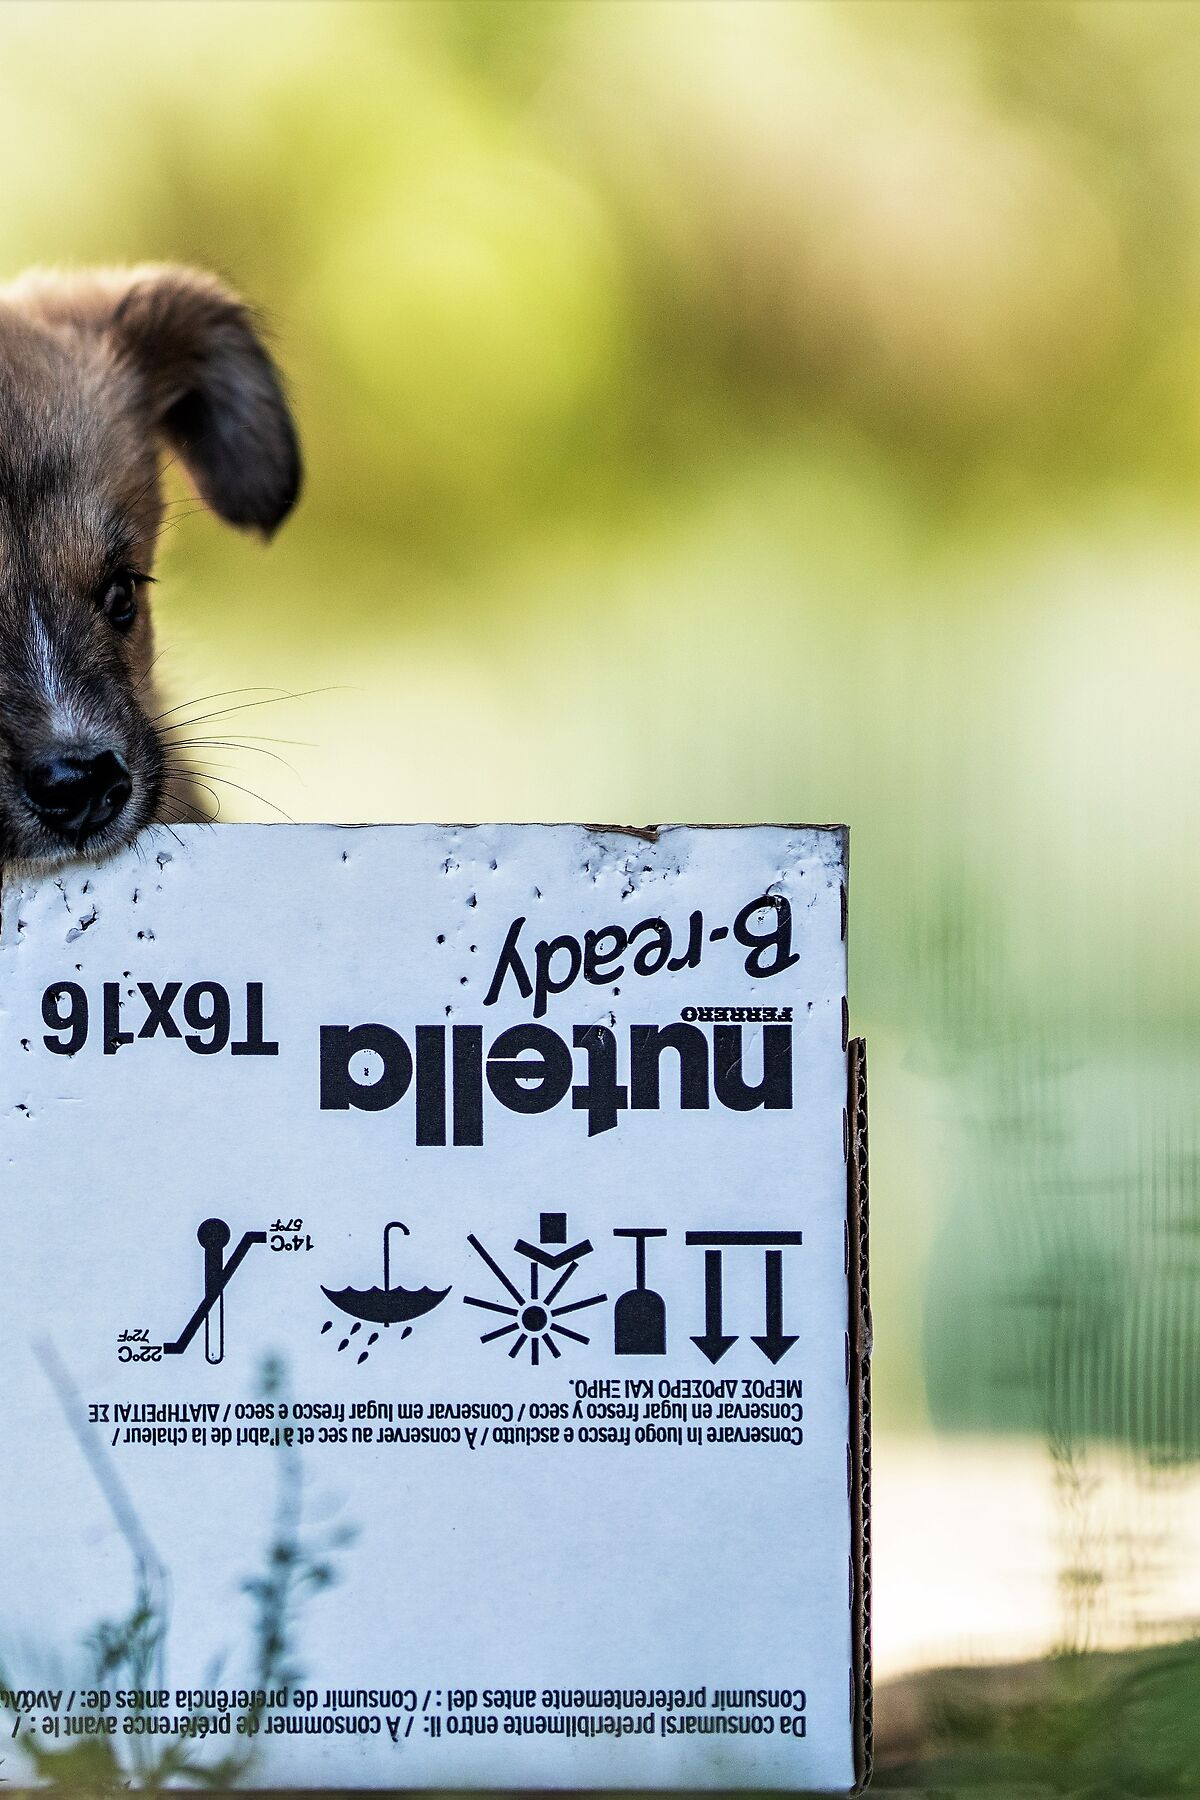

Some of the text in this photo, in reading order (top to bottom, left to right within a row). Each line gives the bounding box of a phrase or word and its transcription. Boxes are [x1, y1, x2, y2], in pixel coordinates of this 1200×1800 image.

[483, 893, 801, 1019] B-ready
[41, 980, 279, 1057] T6x16
[679, 1005, 794, 1023] FERRERO
[319, 1023, 793, 1148] nutella
[568, 1379, 803, 1400] ΜΕΡΟΣ ΔΡΟΣΕΡΟ ΚΑΙ ΞΗΡΟ.
[87, 1399, 804, 1424] Conservar en lugar fresco y seco Conservar em lugar fresco e seco ΔΙΑΤΗΡΕΙΤΑΙ ΣΕ
[122, 1422, 804, 1451] Conservare in luogo fresco e asciutto À conserver au sec et l’abri de la chaleur
[79, 1689, 112, 1713] de:
[292, 1689, 318, 1713] de
[322, 1689, 418, 1713] Consumir
[447, 1689, 479, 1713] del
[481, 1689, 537, 1711] antes
[541, 1685, 707, 1713] preferentemente
[710, 1689, 807, 1713] Consumir
[264, 1711, 807, 1743] Da consumarsi preferibilmente entro il: À consommer
